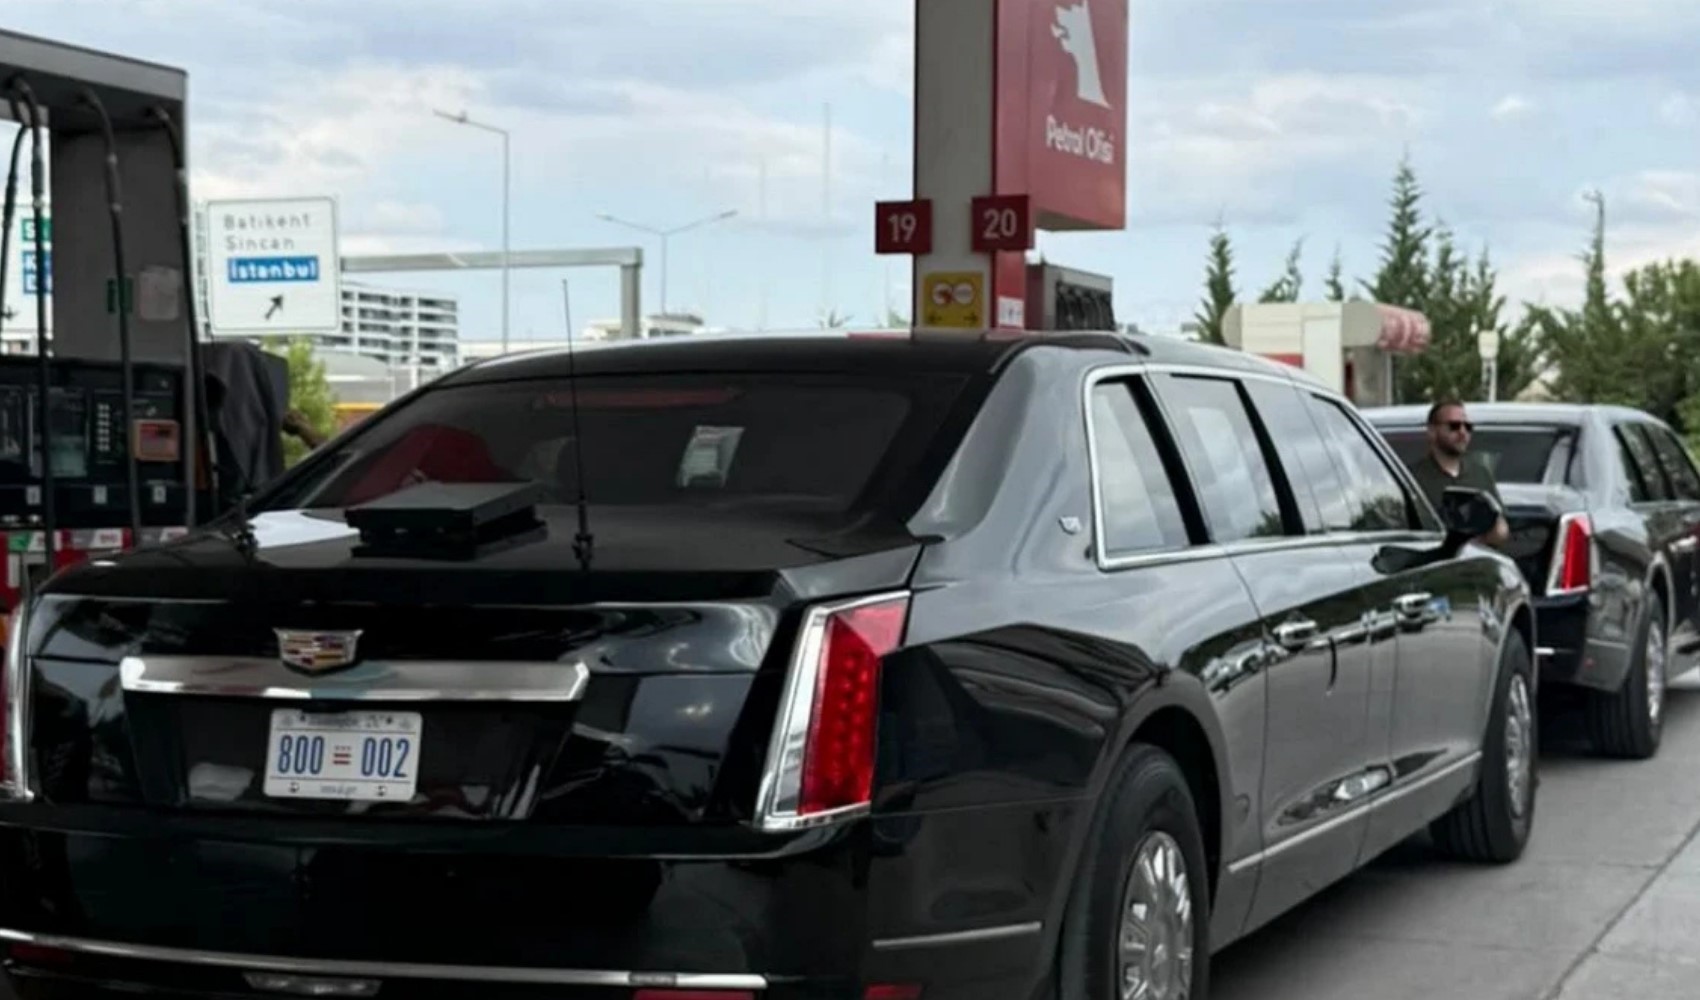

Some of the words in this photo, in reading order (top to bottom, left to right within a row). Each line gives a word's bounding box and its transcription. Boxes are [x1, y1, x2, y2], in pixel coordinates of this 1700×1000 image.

[1046, 114, 1084, 155] Petrol
[1086, 127, 1114, 165] Ofisi
[888, 213, 917, 243] 19
[982, 208, 1017, 239] 20
[225, 235, 295, 251] Sincan
[277, 734, 325, 775] 800
[361, 737, 410, 778] 002
